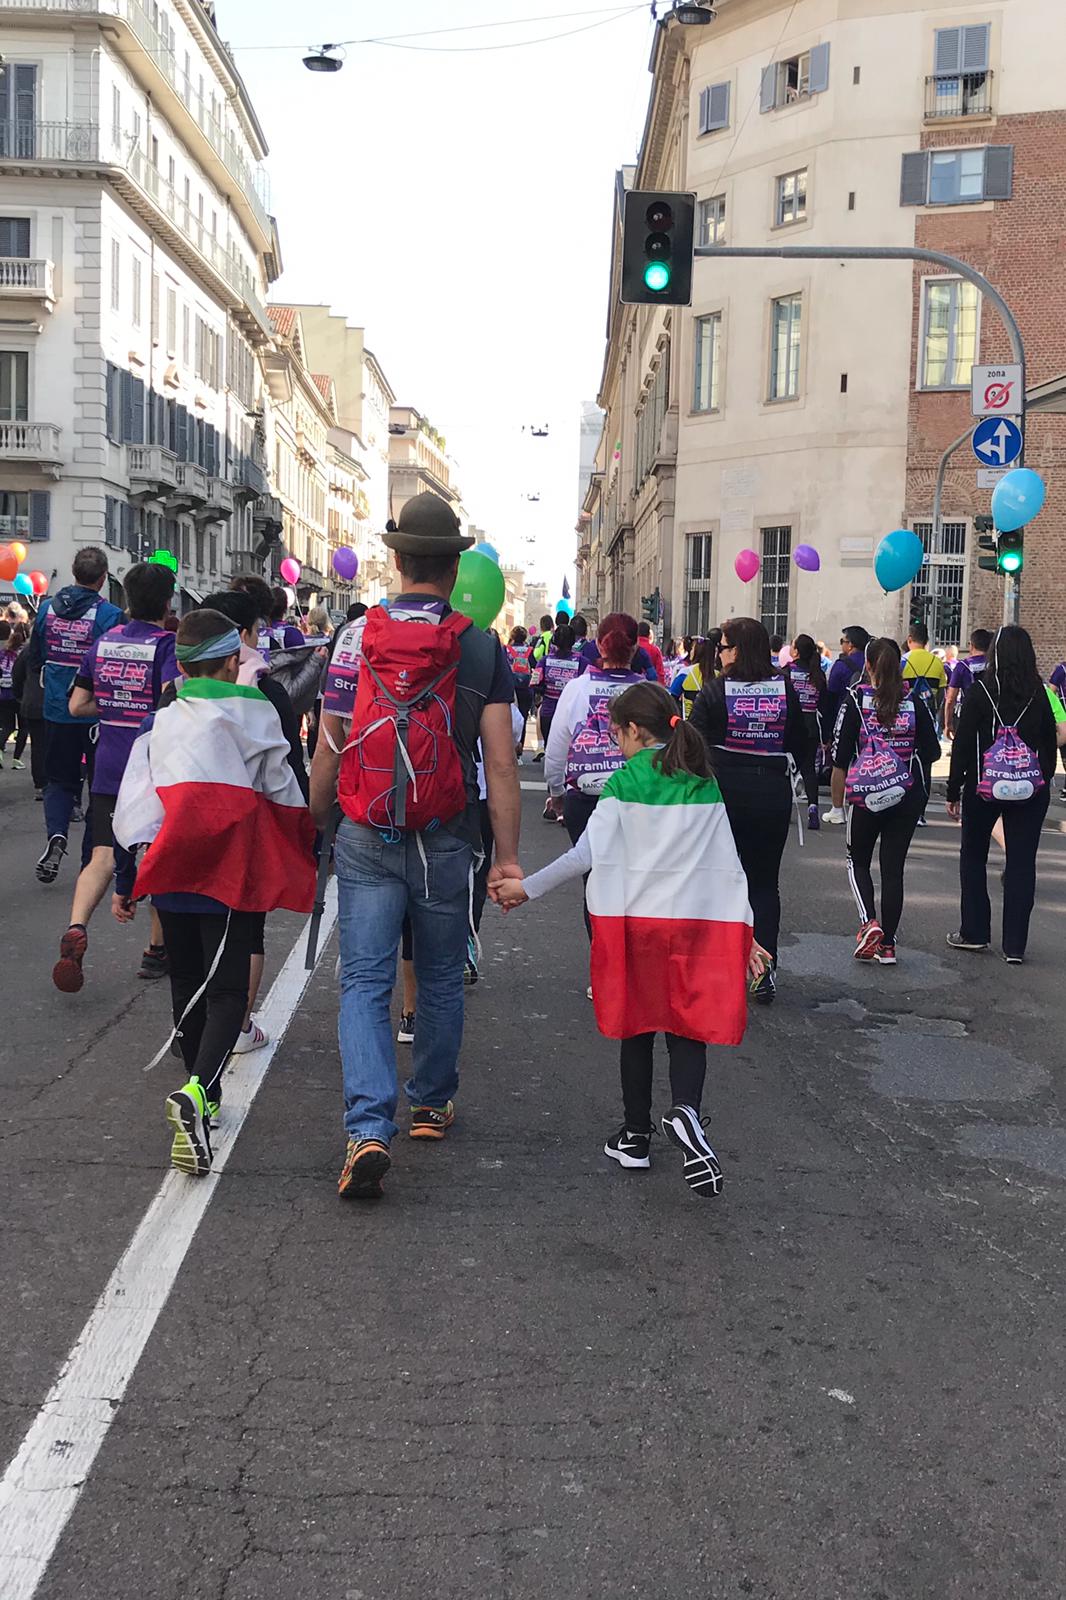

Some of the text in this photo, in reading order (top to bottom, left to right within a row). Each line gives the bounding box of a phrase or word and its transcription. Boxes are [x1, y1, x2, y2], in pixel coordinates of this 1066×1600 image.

[987, 370, 1006, 378] zona
[103, 648, 148, 659] BANCO BPM
[595, 687, 621, 696] BANCO
[99, 698, 148, 710] Stramilano
[731, 730, 780, 739] Stramilano
[568, 760, 627, 772] Stramilan
[853, 772, 910, 793] Stramilano
